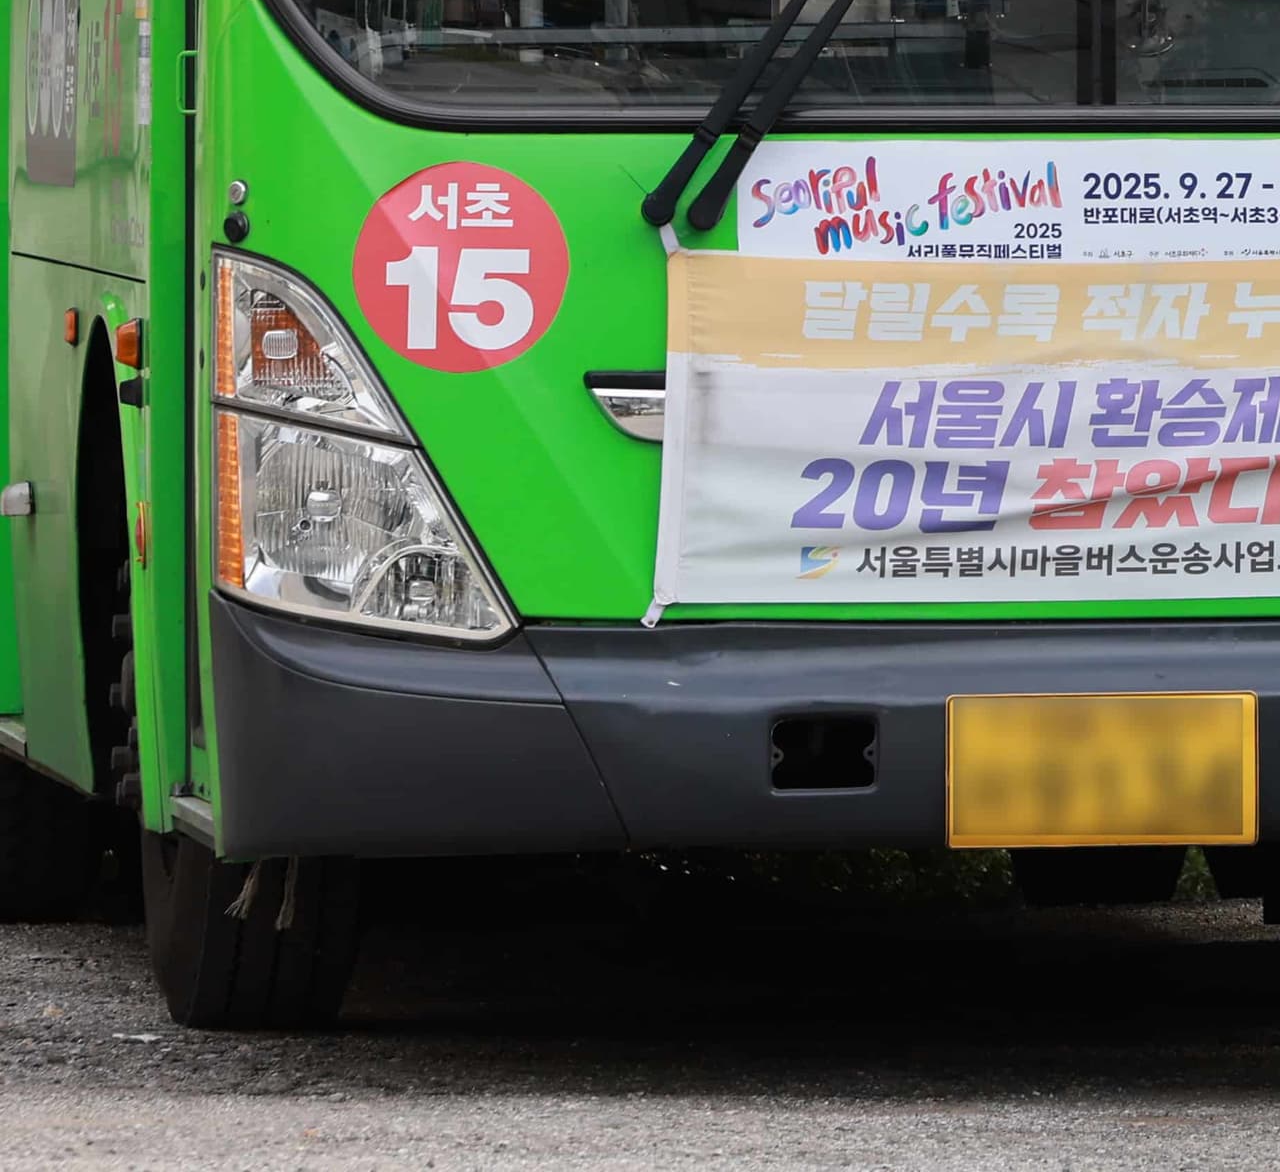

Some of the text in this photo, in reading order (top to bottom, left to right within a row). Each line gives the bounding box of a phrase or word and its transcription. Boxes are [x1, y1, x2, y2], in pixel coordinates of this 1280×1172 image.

[408, 182, 514, 230] 서초
[928, 161, 1063, 229] festival
[1083, 172, 1170, 200] 2025.
[1179, 172, 1206, 200] 9.
[1216, 172, 1252, 200] 27
[907, 243, 1063, 259] 서리풀뮤직페스티벌
[1014, 223, 1062, 239] 2025
[386, 246, 534, 350] 15
[801, 280, 1061, 343] 달릴수록
[1082, 280, 1210, 341] 적자
[858, 379, 1077, 449] 서울시
[791, 458, 1010, 533] 20년
